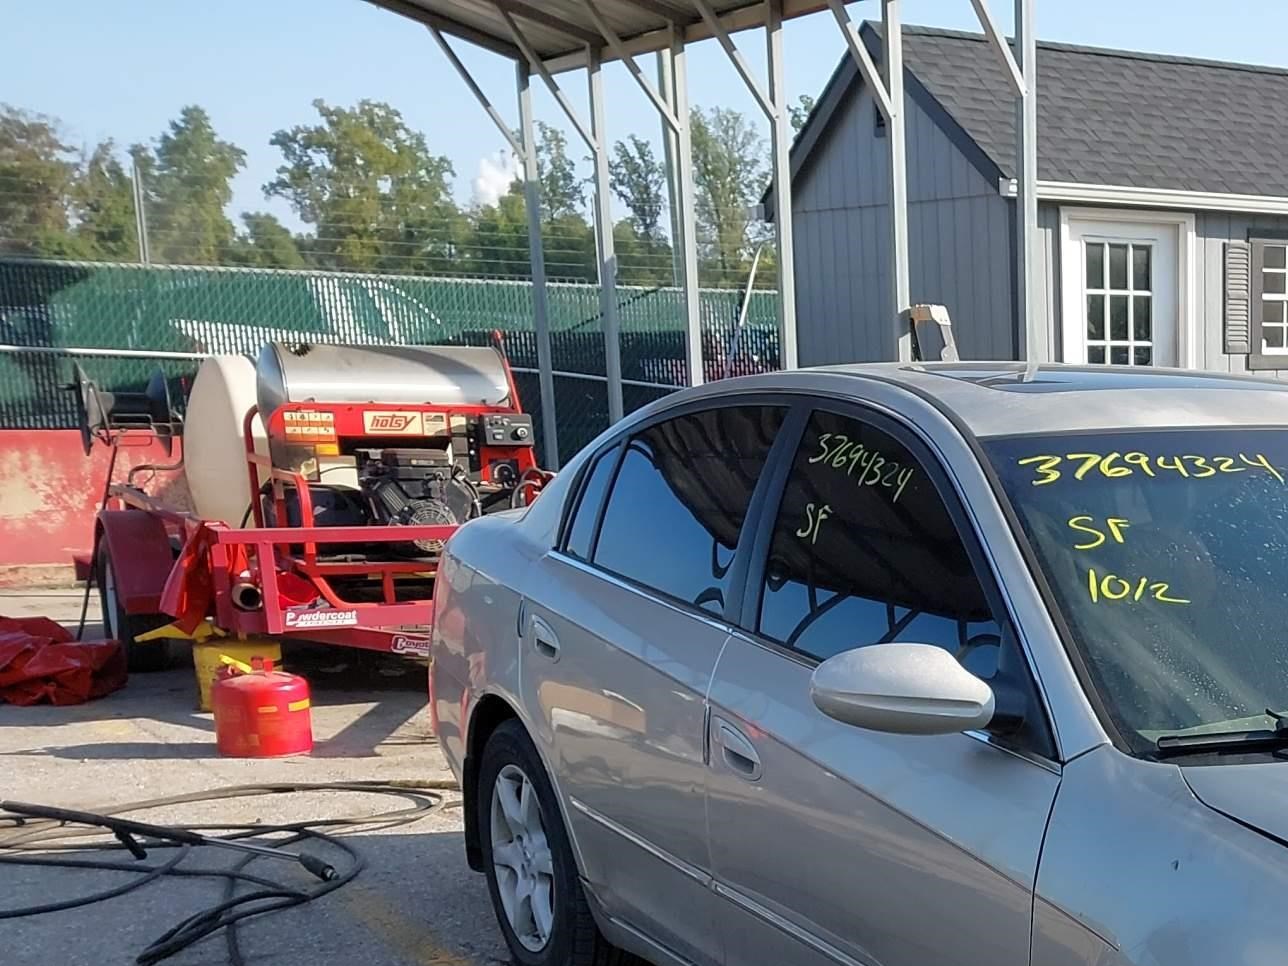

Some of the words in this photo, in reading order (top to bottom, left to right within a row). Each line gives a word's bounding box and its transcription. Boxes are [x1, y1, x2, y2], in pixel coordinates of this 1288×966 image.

[371, 414, 417, 431] hotsy
[809, 433, 914, 503] 37694324
[1018, 451, 1285, 486] 37694324
[796, 503, 833, 545] SF
[1068, 516, 1131, 550] SF
[393, 636, 430, 651] Coyot
